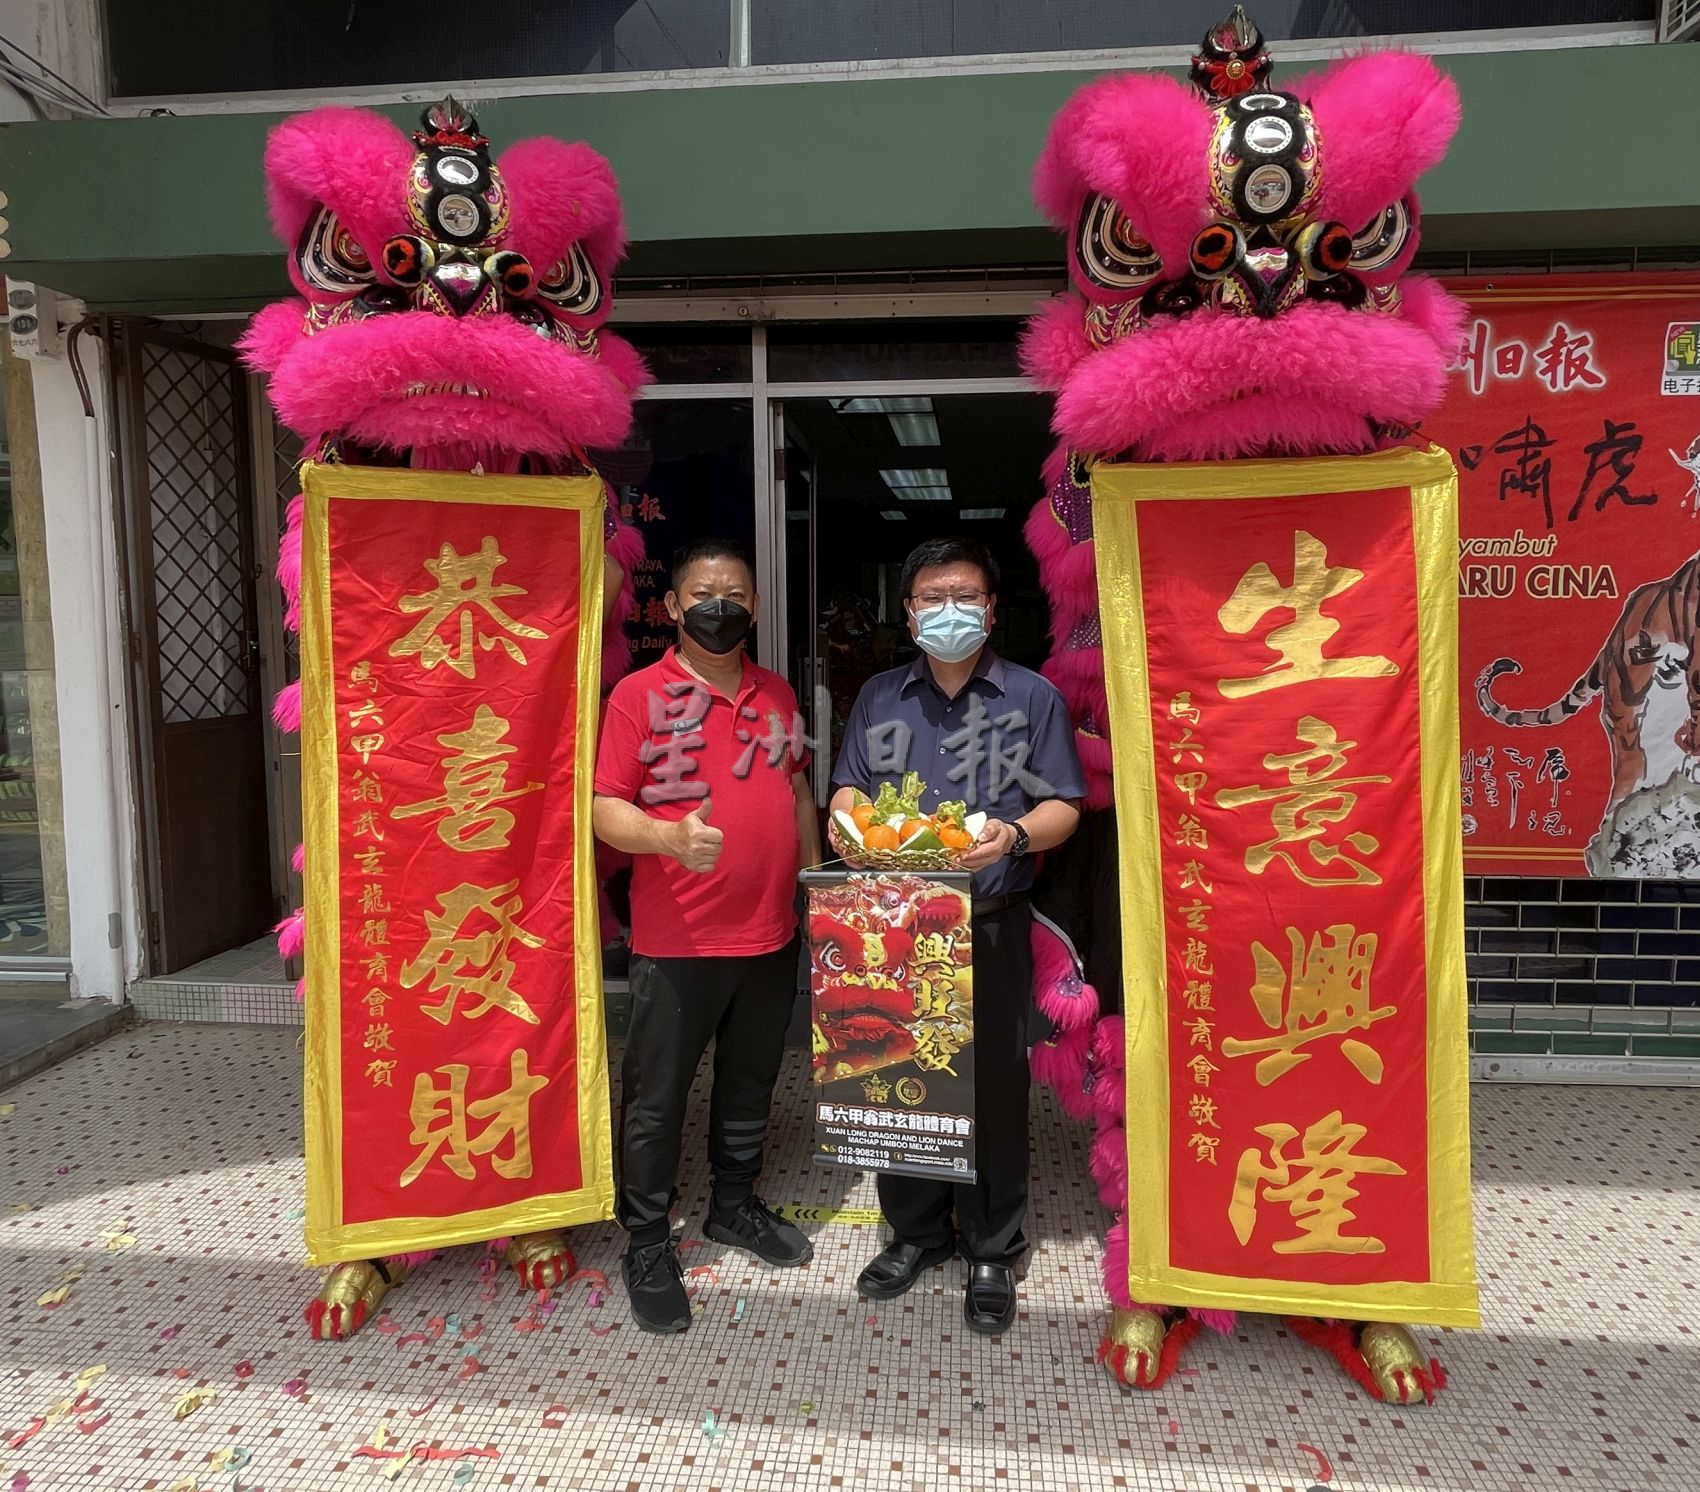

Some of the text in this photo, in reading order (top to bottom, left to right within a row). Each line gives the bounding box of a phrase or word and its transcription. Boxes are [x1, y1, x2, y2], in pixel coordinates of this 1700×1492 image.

[1664, 378, 1700, 393] 电子
[1526, 566, 1618, 597] CINA
[388, 535, 550, 1187] 恭喜發財
[1214, 529, 1407, 1254] 生意興隆
[819, 1104, 972, 1136] 馬六甲翁武玄龍體育會
[826, 1126, 964, 1148] XUAN LONG DRAGON AND LION DANCE
[848, 1136, 940, 1153] MACHAP UMBOO MELAKA
[837, 1145, 890, 1158] 012-9082119
[837, 1154, 890, 1168] 018-3855978
